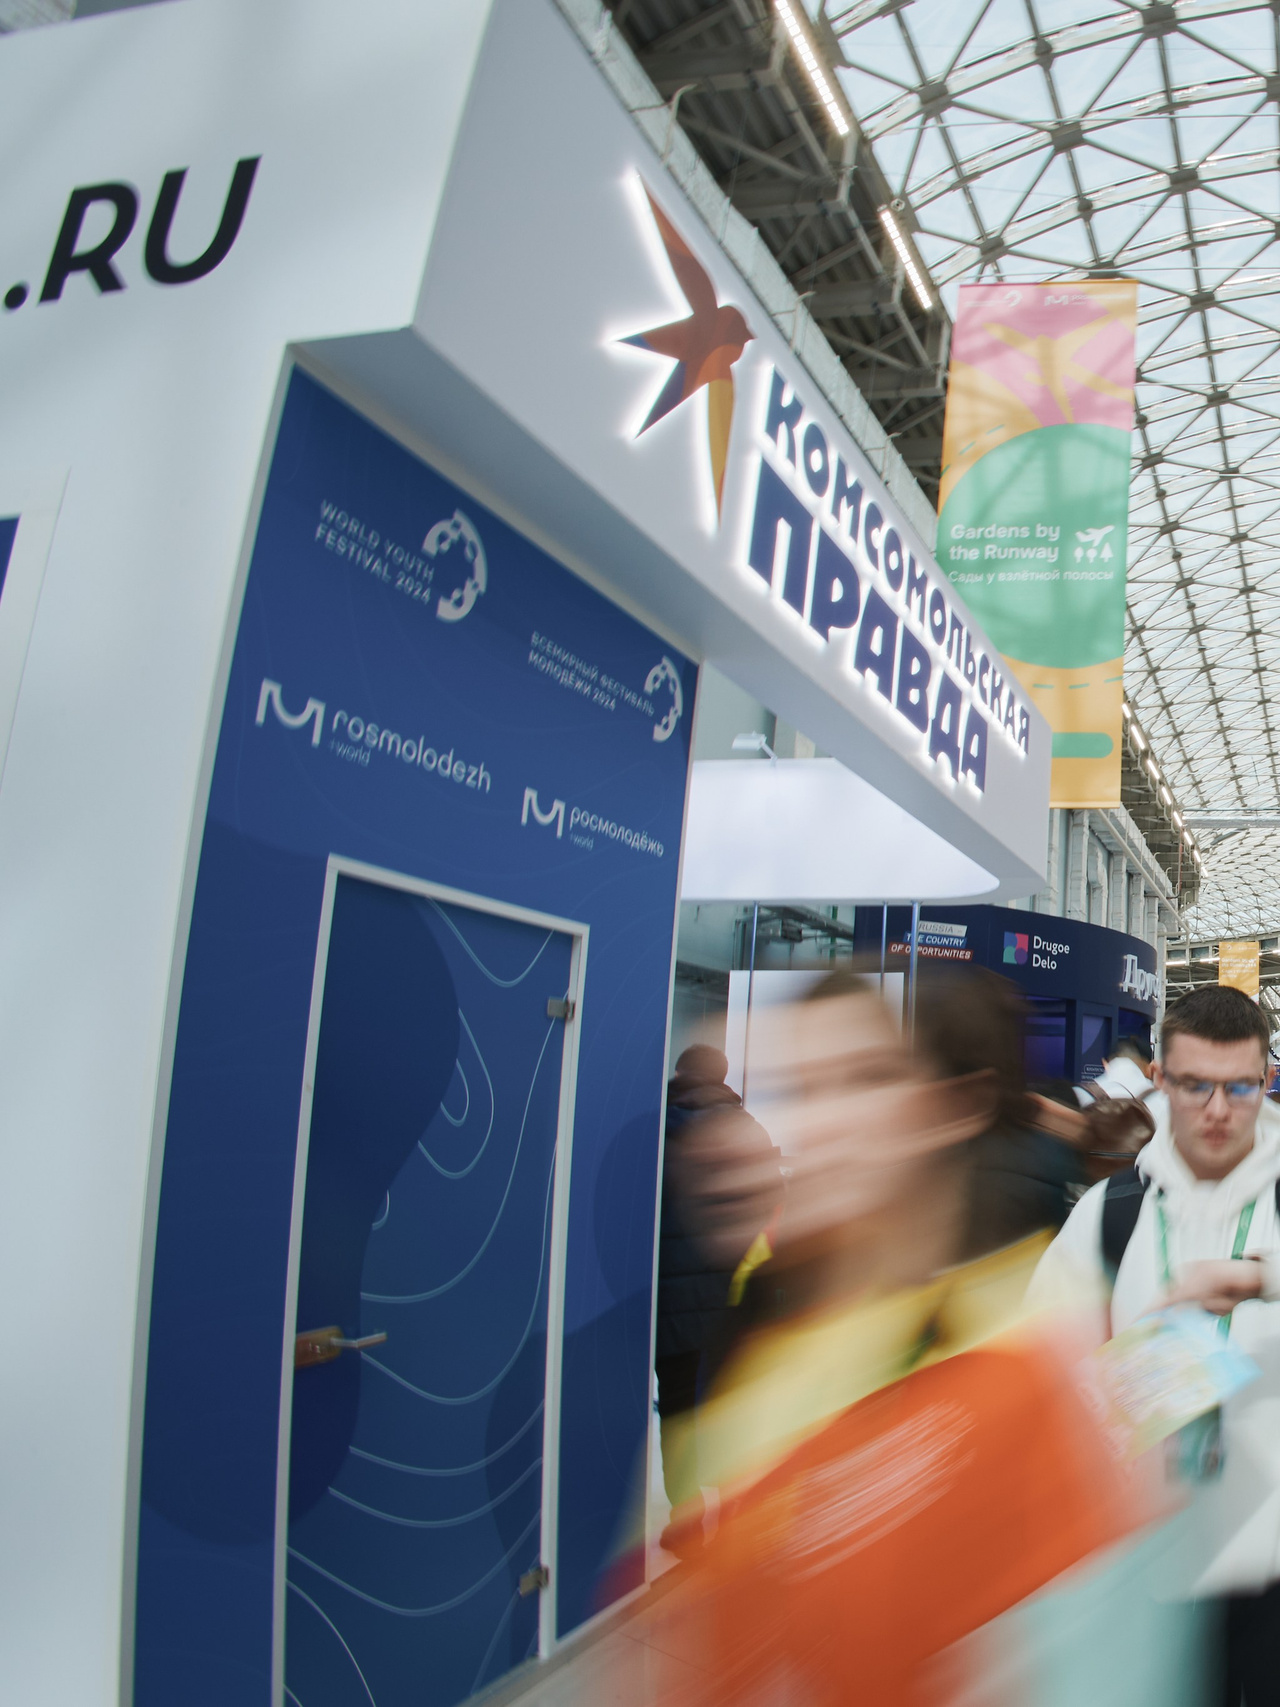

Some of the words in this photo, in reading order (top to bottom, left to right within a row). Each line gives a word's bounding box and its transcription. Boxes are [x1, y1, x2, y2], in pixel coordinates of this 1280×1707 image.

[320, 499, 380, 550] WORLD
[383, 539, 435, 584] YOUTH
[950, 524, 1031, 540] Gardens
[1035, 523, 1061, 541] by
[315, 522, 391, 583] FESTIVAL
[395, 570, 432, 605] 2024
[764, 363, 1031, 756] КОМСОМОЛЬСКАЯ
[949, 545, 980, 561] the
[983, 544, 1059, 563] Runway
[948, 571, 984, 583] Сады
[986, 573, 995, 585] у
[997, 569, 1060, 583] взлётной
[1062, 570, 1114, 581] полосы
[748, 454, 989, 794] ПРАВДА
[528, 649, 593, 698] МОЛОДЁЖИ
[592, 687, 617, 712] 2024
[531, 630, 600, 683] ВСЕМИРНЫЙ
[600, 674, 655, 717] ФЕСТИВАЛЬ
[332, 709, 492, 794] rosmolodezh
[569, 806, 664, 858] росмолодёжь
[906, 933, 924, 943] TE
[925, 935, 964, 947] COUNTRY
[918, 922, 954, 934] RUSSIA
[1033, 935, 1070, 955] Drugoe
[891, 944, 904, 953] OF
[905, 946, 971, 960] OPORTUNITIES
[1032, 953, 1057, 970] Delo
